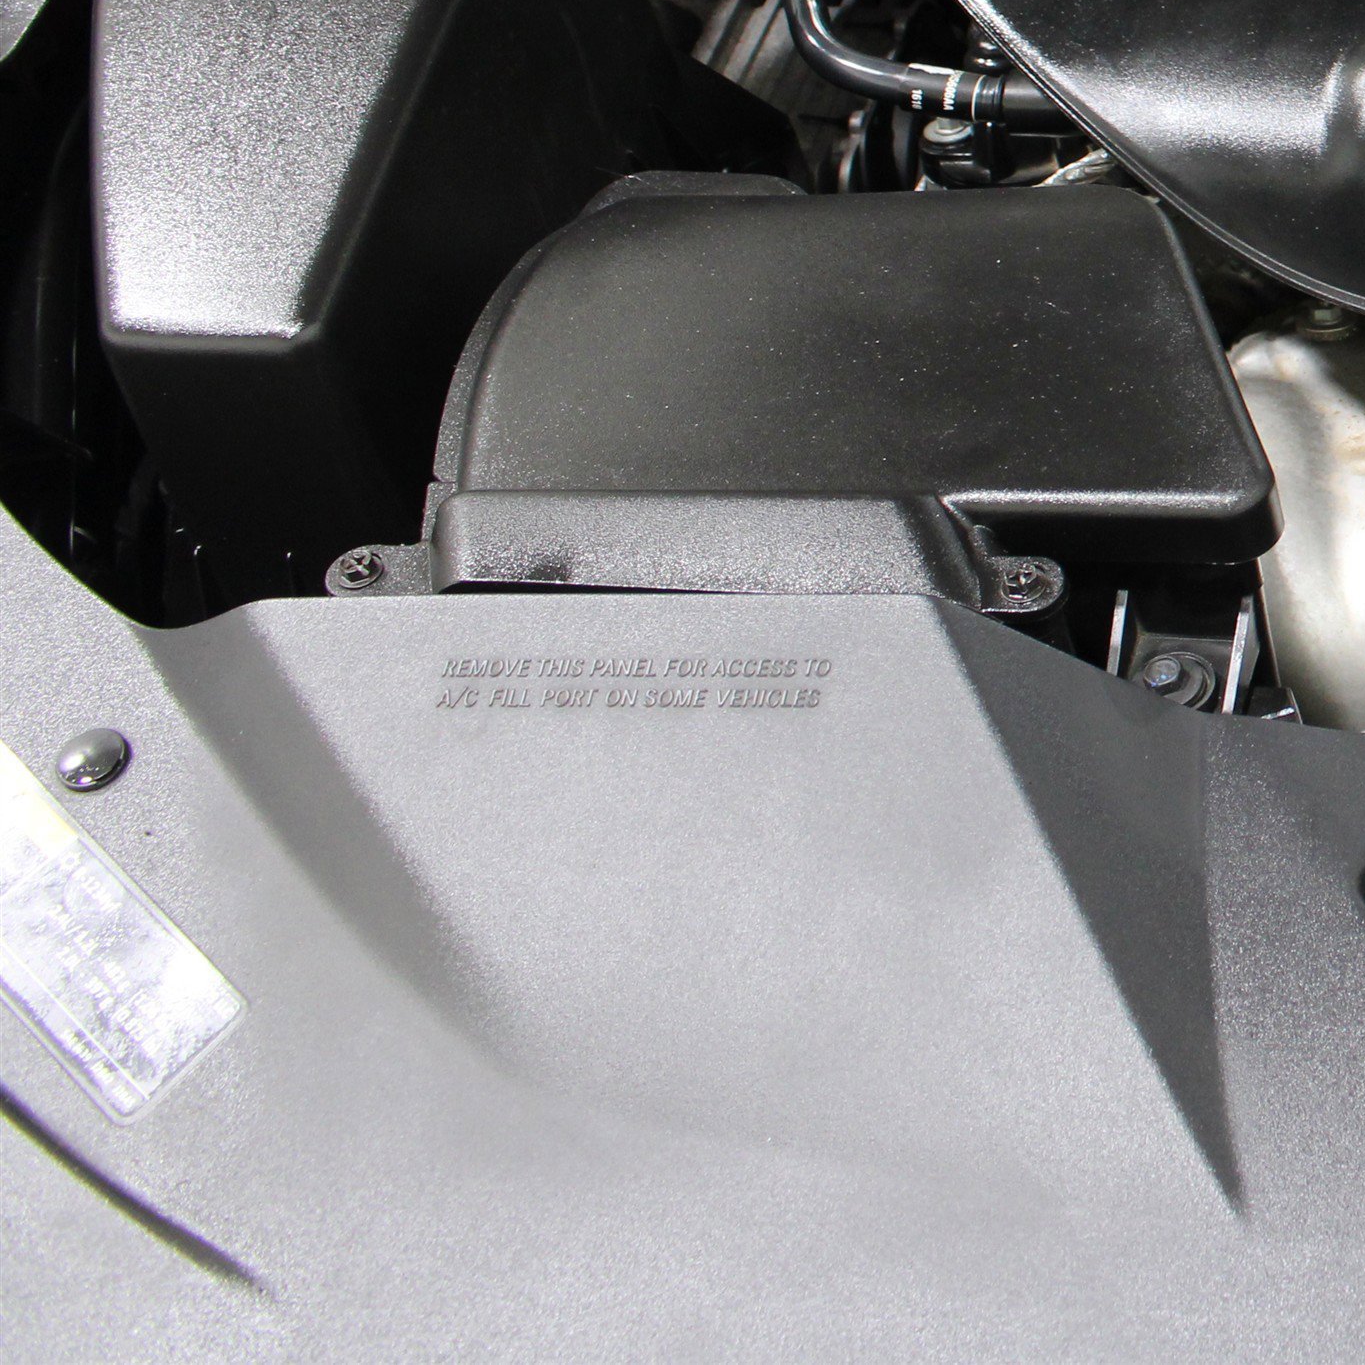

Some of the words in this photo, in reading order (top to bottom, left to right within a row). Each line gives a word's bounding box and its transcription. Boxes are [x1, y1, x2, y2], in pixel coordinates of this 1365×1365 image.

[440, 658, 531, 678] REMOVE
[536, 658, 583, 678] THIS
[588, 658, 657, 678] PANEL
[662, 658, 707, 678] FOR
[710, 658, 798, 678] ACCESS
[803, 658, 831, 678] TO
[436, 687, 478, 708] A/C
[488, 687, 531, 708] FILL
[539, 687, 598, 708] PORT
[605, 687, 639, 708] ON
[643, 687, 706, 708] SOME
[716, 687, 820, 708] VEHICLES
